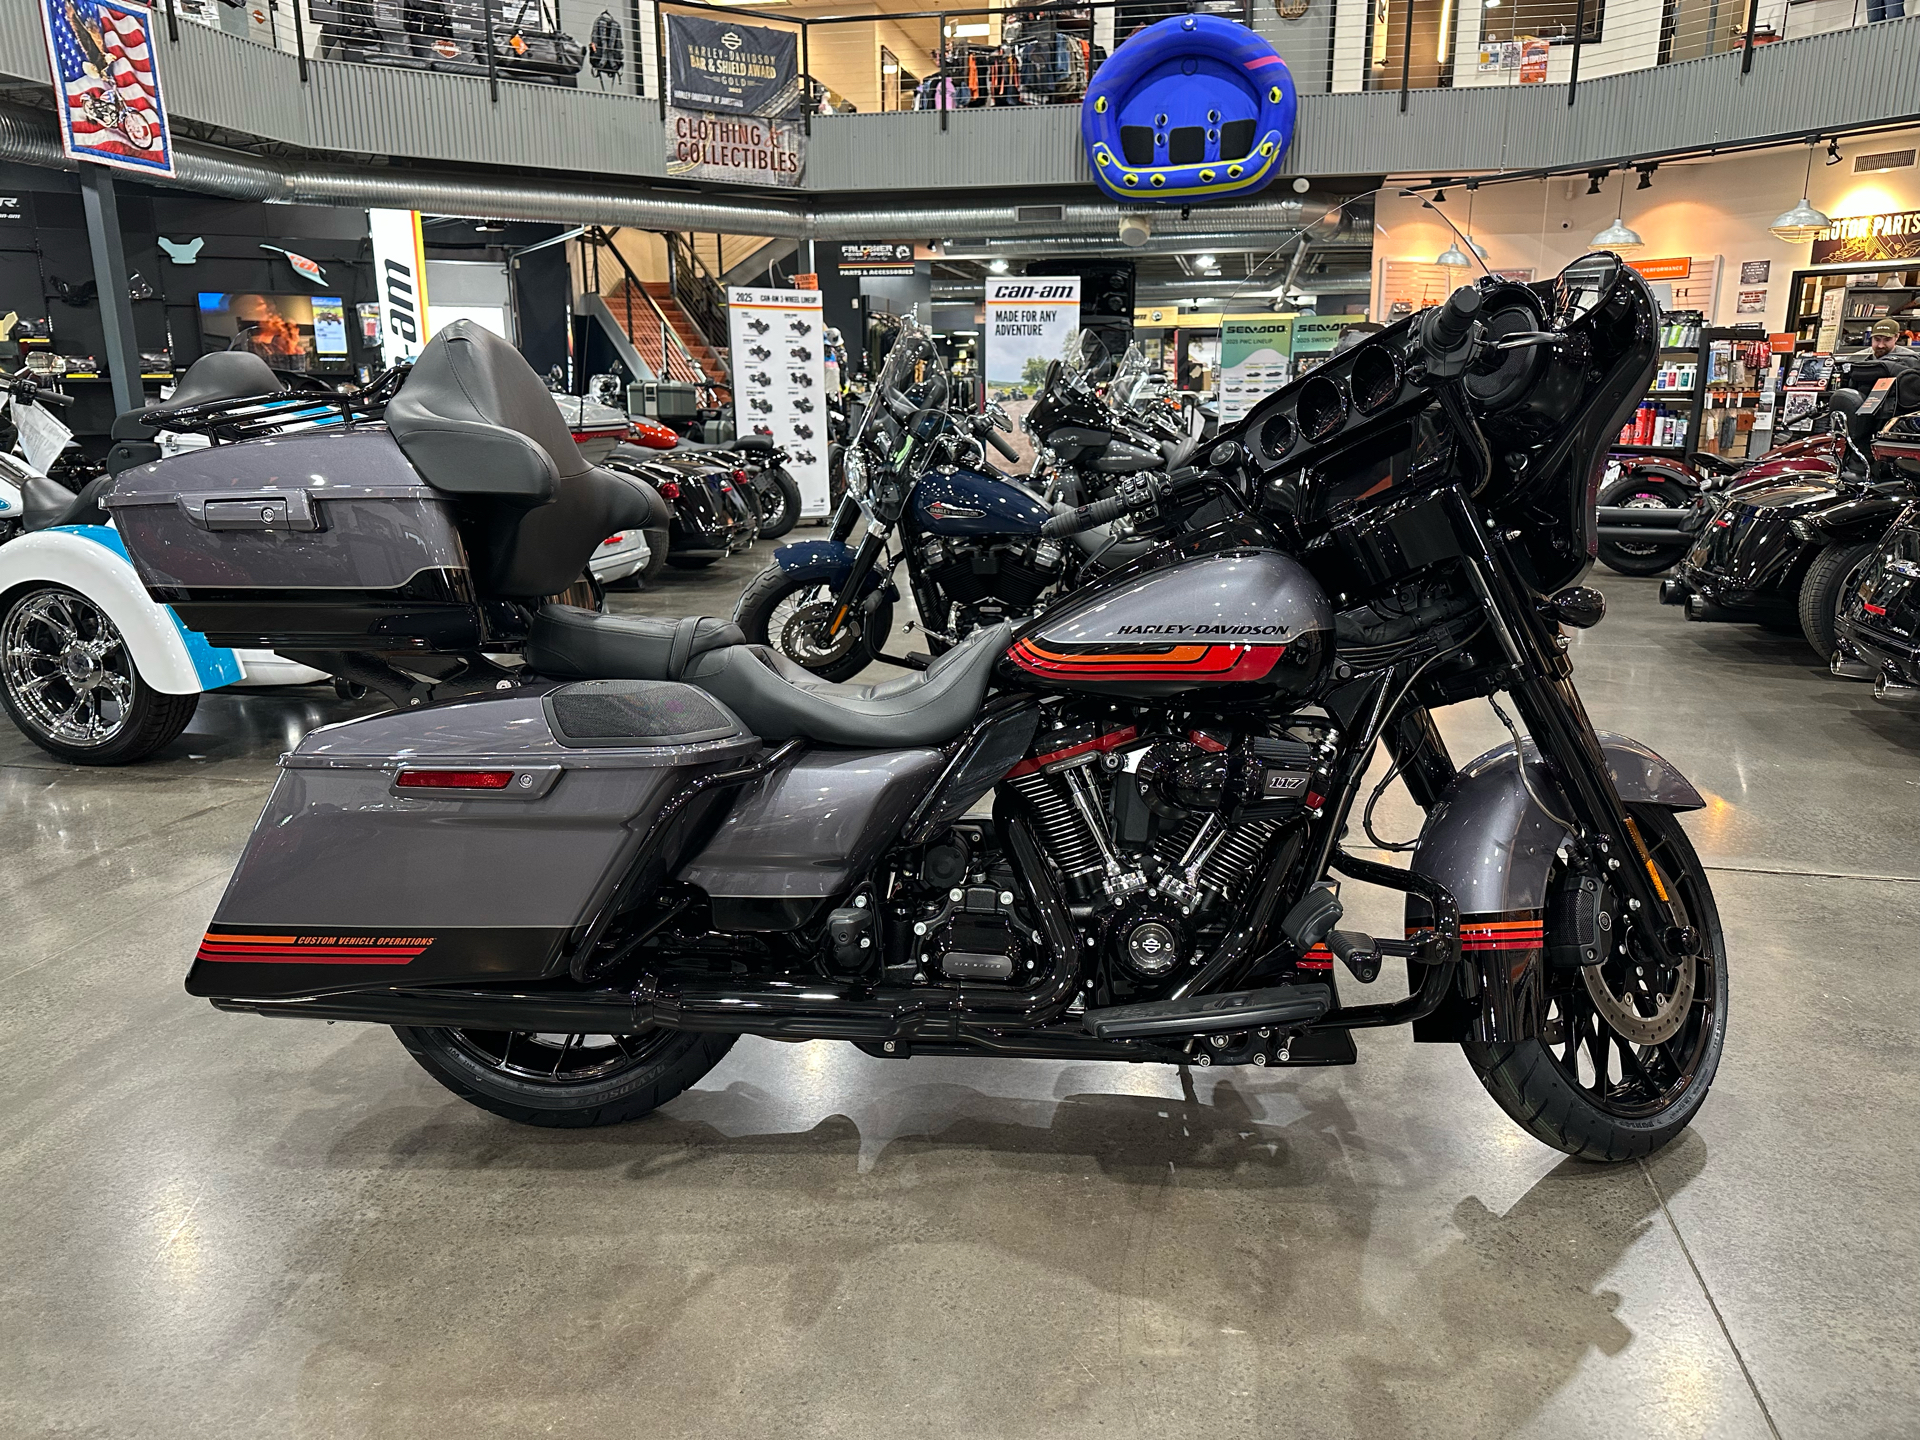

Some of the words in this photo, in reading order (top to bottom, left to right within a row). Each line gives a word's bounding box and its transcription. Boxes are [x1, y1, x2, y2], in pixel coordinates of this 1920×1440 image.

[687, 44, 776, 65] HARLEY-DAVIDSON
[690, 55, 707, 71] BAR
[708, 58, 716, 72] &
[716, 60, 746, 76] SHIELD
[747, 64, 777, 79] AWARD
[721, 76, 747, 87] GOLD
[676, 117, 761, 147] CLOTHING
[677, 141, 797, 173] COLLECTIBLES
[1872, 213, 1920, 238] PARTS
[868, 268, 914, 276] ACCESSORIES
[1643, 265, 1683, 274] PERFORMANCE
[736, 292, 753, 302] 2025
[995, 286, 1074, 298] can-am
[995, 311, 1018, 322] MADE
[1021, 311, 1037, 322] FOR
[1039, 310, 1057, 323] ANY
[995, 324, 1043, 336] ADVENTURE
[1311, 336, 1333, 344] SWITCH
[1117, 624, 1290, 635] HARLEY-DAVIDSON
[1269, 776, 1306, 789] 117
[297, 936, 337, 945] CUSTOM
[338, 937, 376, 945] VEHICLE
[377, 937, 435, 946] OPERATIONS
